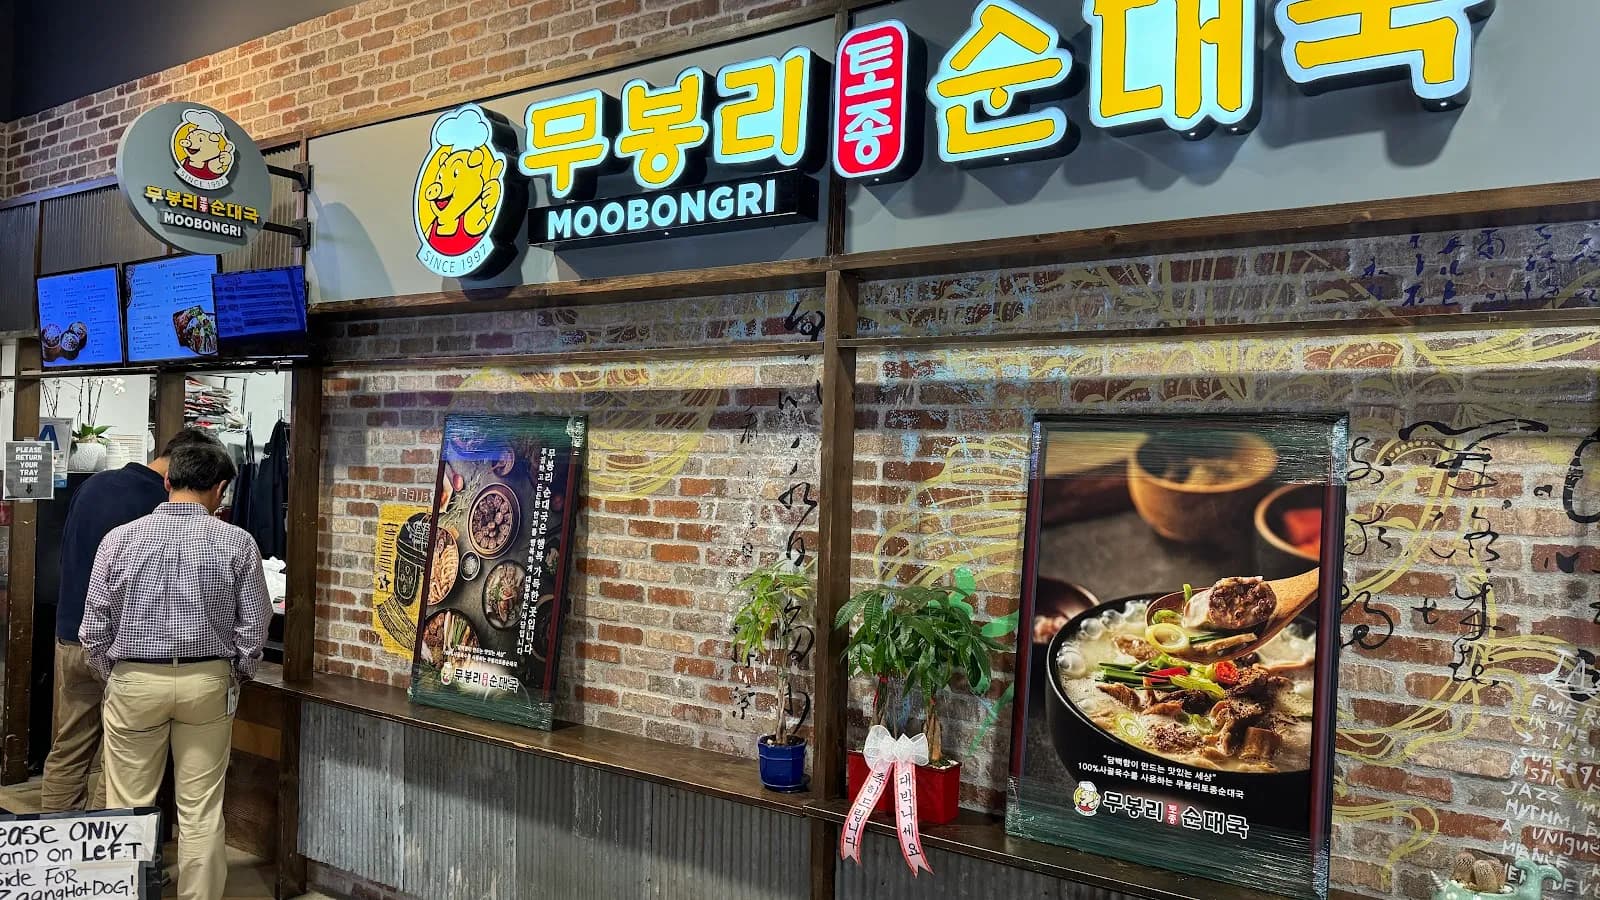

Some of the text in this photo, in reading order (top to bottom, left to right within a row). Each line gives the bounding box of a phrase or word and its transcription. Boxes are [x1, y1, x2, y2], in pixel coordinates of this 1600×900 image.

[520, 50, 809, 196] 무봉리
[844, 36, 893, 165] 토종
[145, 185, 198, 211] 무봉리
[210, 200, 259, 224] 순대국
[547, 179, 776, 240] MOOBONGRI
[164, 212, 241, 236] MOOBONGRI
[424, 244, 486, 272] SINCE 1997
[15, 446, 42, 454] PLEASE
[39, 424, 59, 450] A
[545, 448, 556, 483] 무봉리
[455, 669, 480, 684] 무봉리
[489, 674, 520, 693] 순대국
[1141, 762, 1165, 774] 만드는
[1168, 767, 1192, 779] 맛있는
[1141, 774, 1173, 787] 사용하는
[1176, 779, 1245, 799] 무봉리토종순대국
[1501, 780, 1562, 806] JAZZ
[899, 772, 920, 857] 대박나세요
[1103, 791, 1163, 822] 무봉리
[1182, 806, 1249, 839] 순대국
